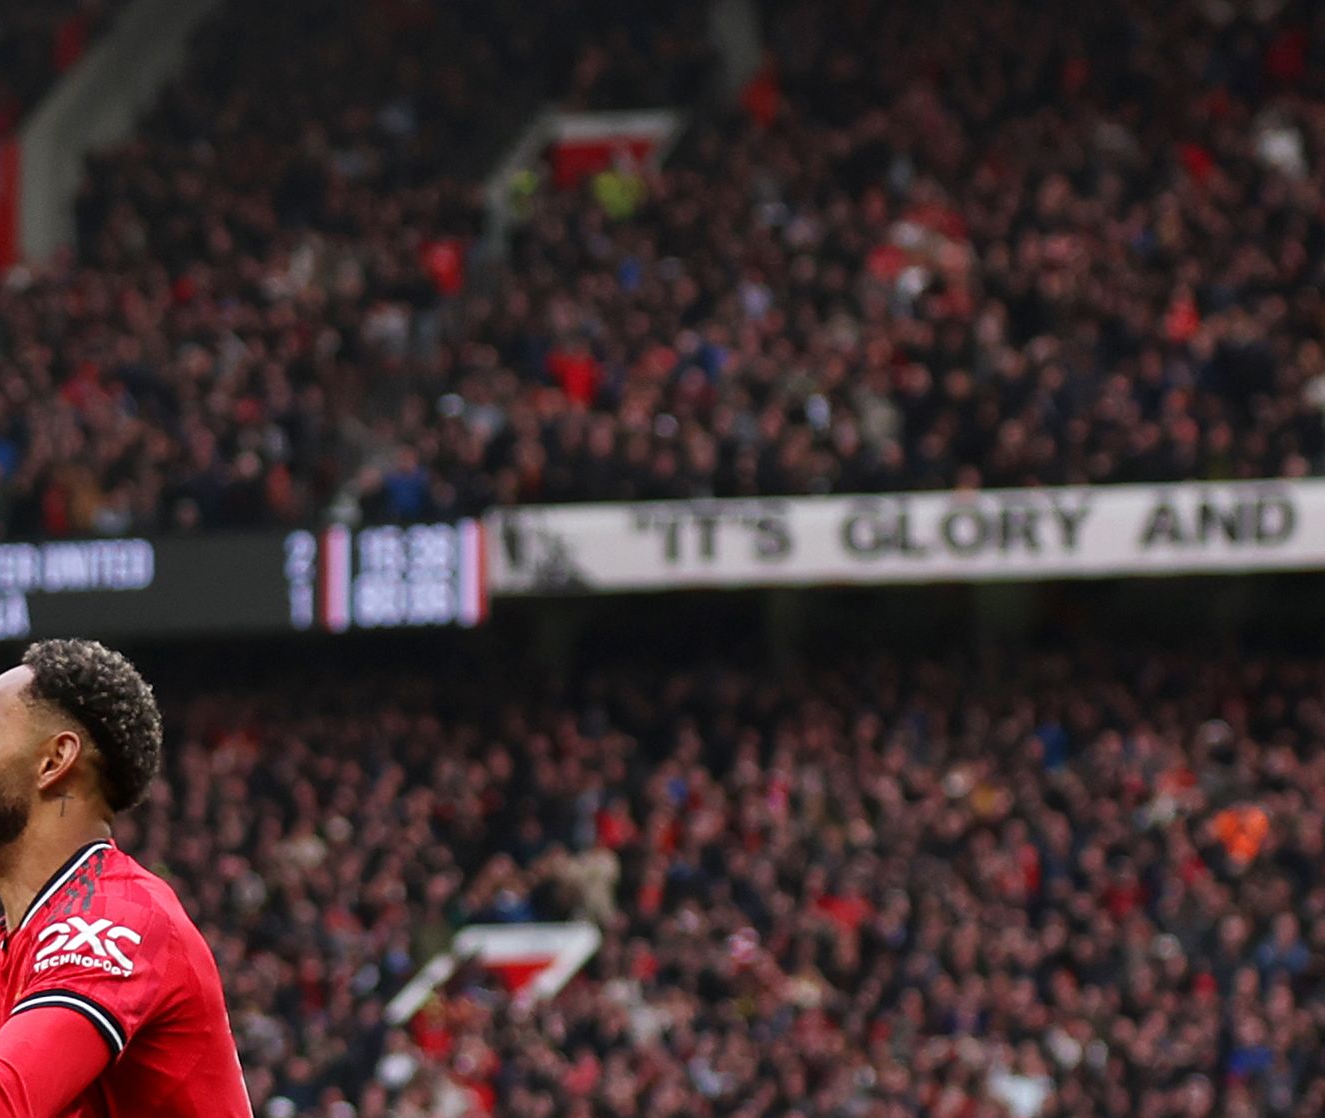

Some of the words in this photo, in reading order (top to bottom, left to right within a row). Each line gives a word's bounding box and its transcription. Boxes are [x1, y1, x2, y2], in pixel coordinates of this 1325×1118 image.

[839, 497, 1089, 561] GLORY
[1137, 492, 1299, 550] AND
[33, 953, 133, 977] TECHNOLOGY
[36, 916, 142, 971] DXC
